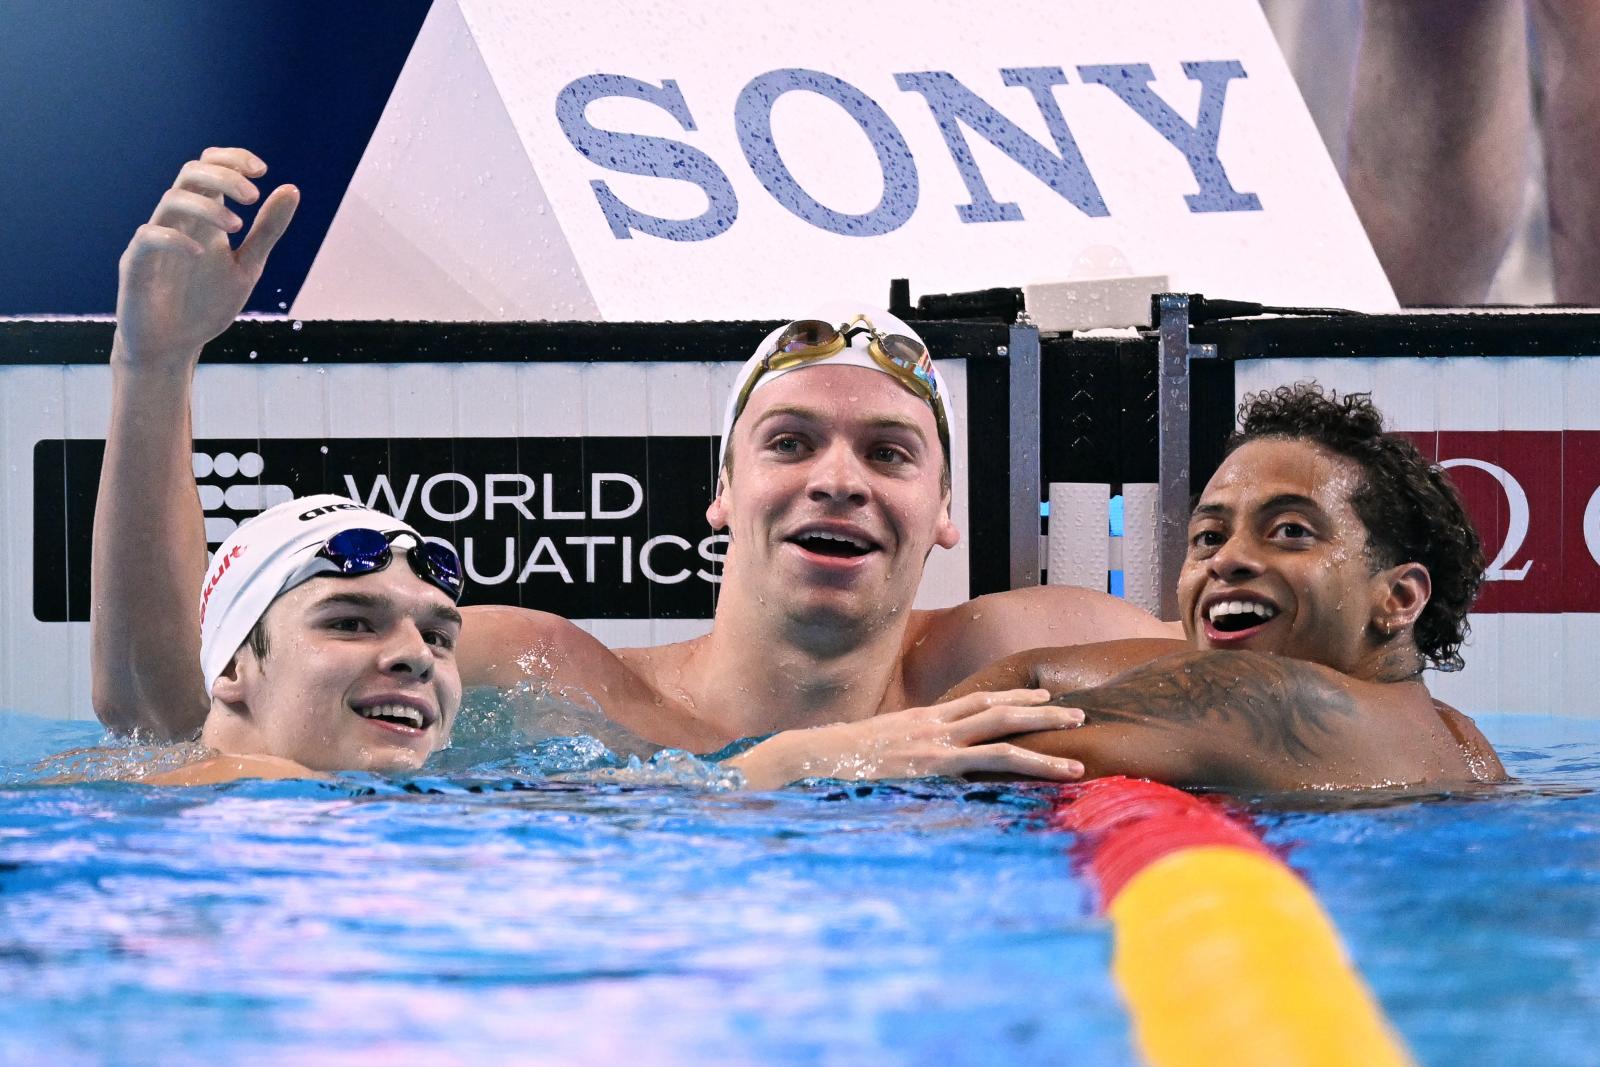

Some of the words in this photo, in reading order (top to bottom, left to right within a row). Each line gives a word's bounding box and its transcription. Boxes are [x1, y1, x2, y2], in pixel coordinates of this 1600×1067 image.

[555, 59, 1264, 242] SONY
[343, 472, 643, 521] WORLD
[200, 545, 246, 630] akult
[421, 535, 729, 586] UATICS
